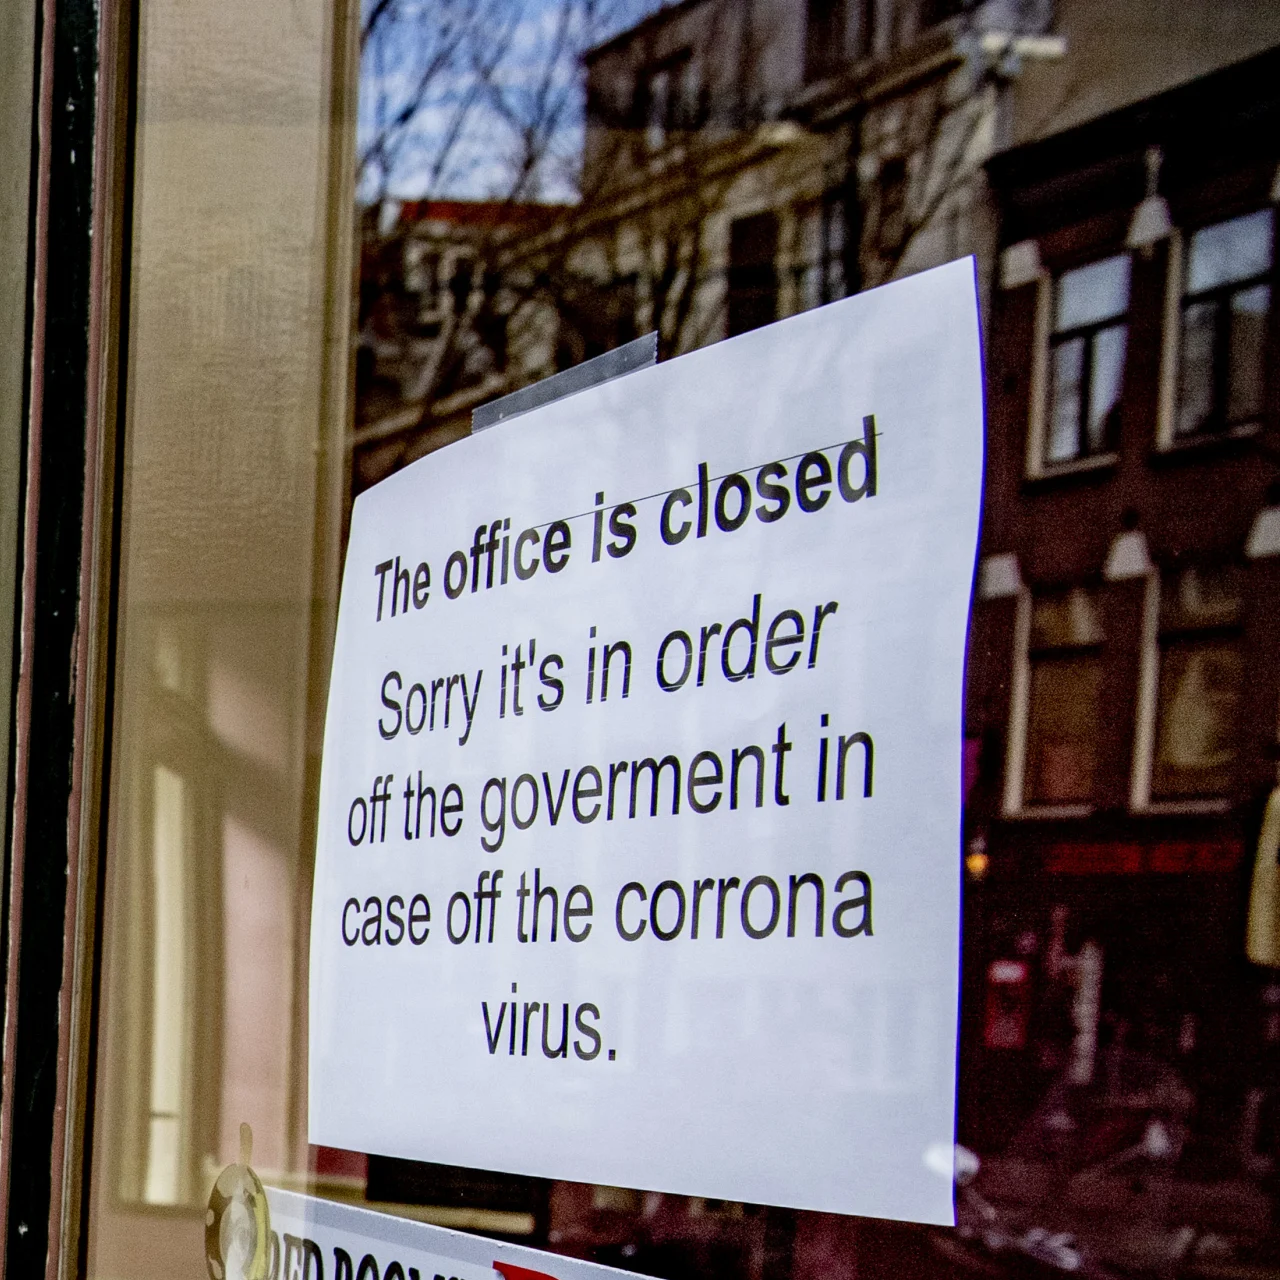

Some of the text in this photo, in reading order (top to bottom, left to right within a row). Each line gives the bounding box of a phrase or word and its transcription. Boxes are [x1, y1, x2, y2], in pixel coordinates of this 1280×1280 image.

[375, 414, 878, 622] The office is closed
[378, 593, 839, 746] Sorry it's in order
[347, 713, 875, 852] off the goverment in
[341, 867, 875, 946] case off the corrona
[480, 982, 617, 1062] virus.
